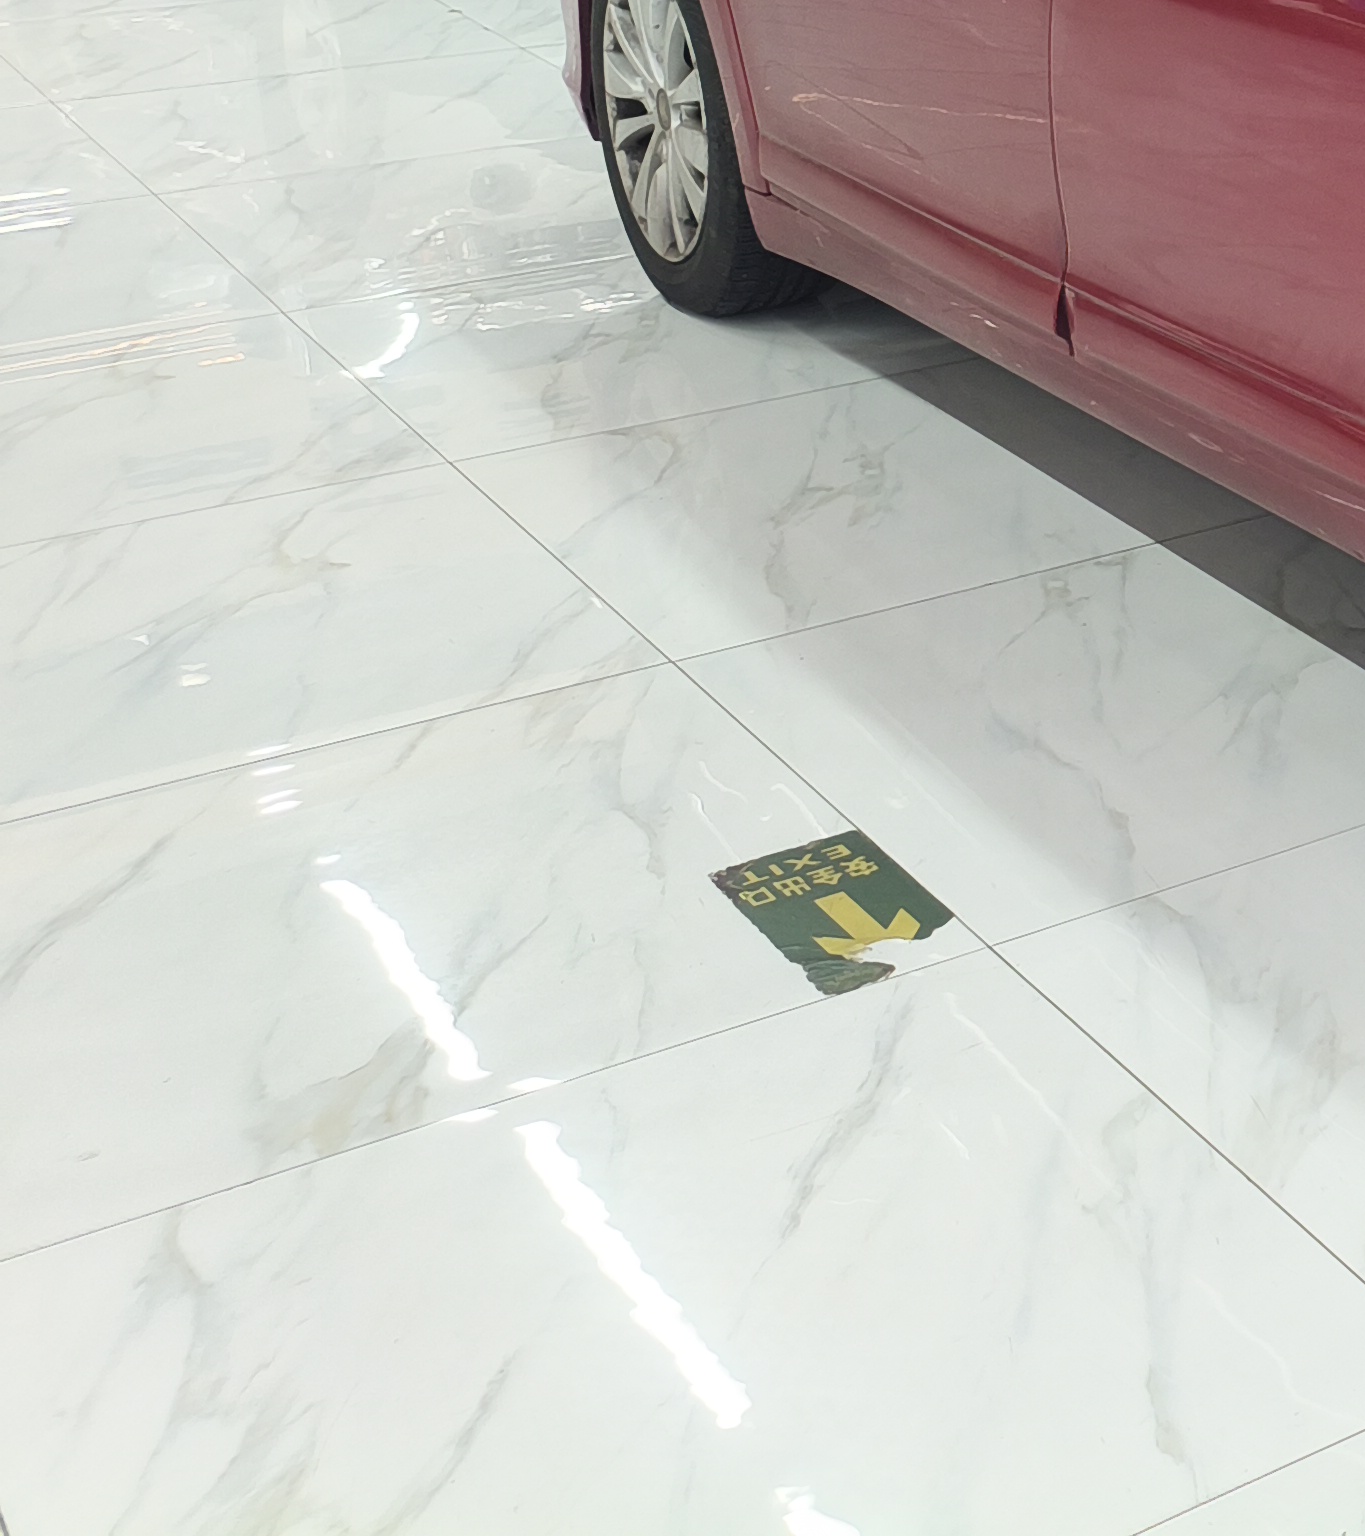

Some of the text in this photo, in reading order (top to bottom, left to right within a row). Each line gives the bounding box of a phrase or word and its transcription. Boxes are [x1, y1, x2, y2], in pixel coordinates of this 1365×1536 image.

[739, 855, 879, 907] 安全出口
[742, 844, 852, 886] EXIT
